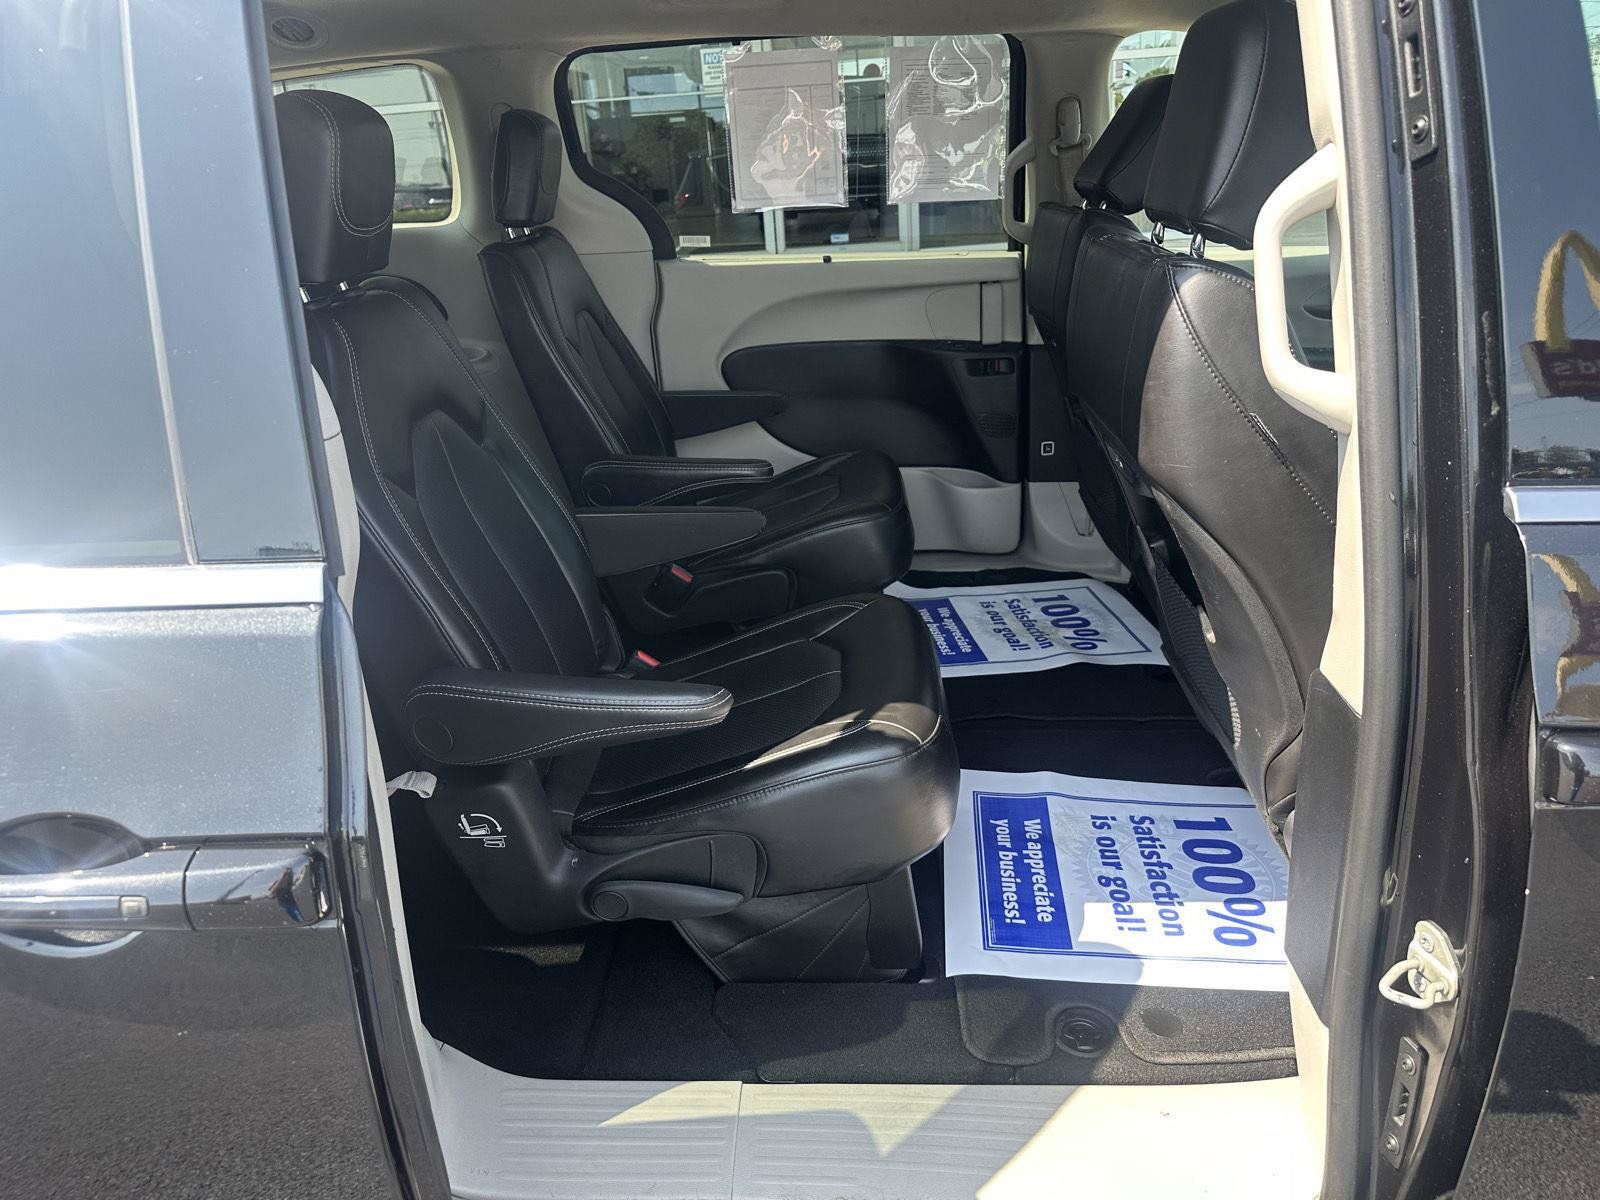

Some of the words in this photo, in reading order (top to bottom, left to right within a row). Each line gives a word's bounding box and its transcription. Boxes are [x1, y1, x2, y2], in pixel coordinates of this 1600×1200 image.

[937, 607, 950, 618] We
[979, 601, 997, 609] is
[986, 610, 1008, 626] our
[1032, 595, 1108, 650] 100%
[927, 623, 956, 655] business!
[942, 618, 972, 653] appreciate
[993, 627, 1031, 651] goal!
[1004, 599, 1054, 650] Satisfaction
[989, 819, 1012, 848] your
[1023, 819, 1043, 839] We
[1090, 814, 1118, 830] is
[1095, 836, 1124, 871] our
[999, 850, 1027, 925] business!
[1022, 841, 1056, 923] appreciate
[1129, 814, 1185, 936] Satisfaction
[1173, 816, 1275, 947] 100%
[1097, 875, 1148, 932] goal!
